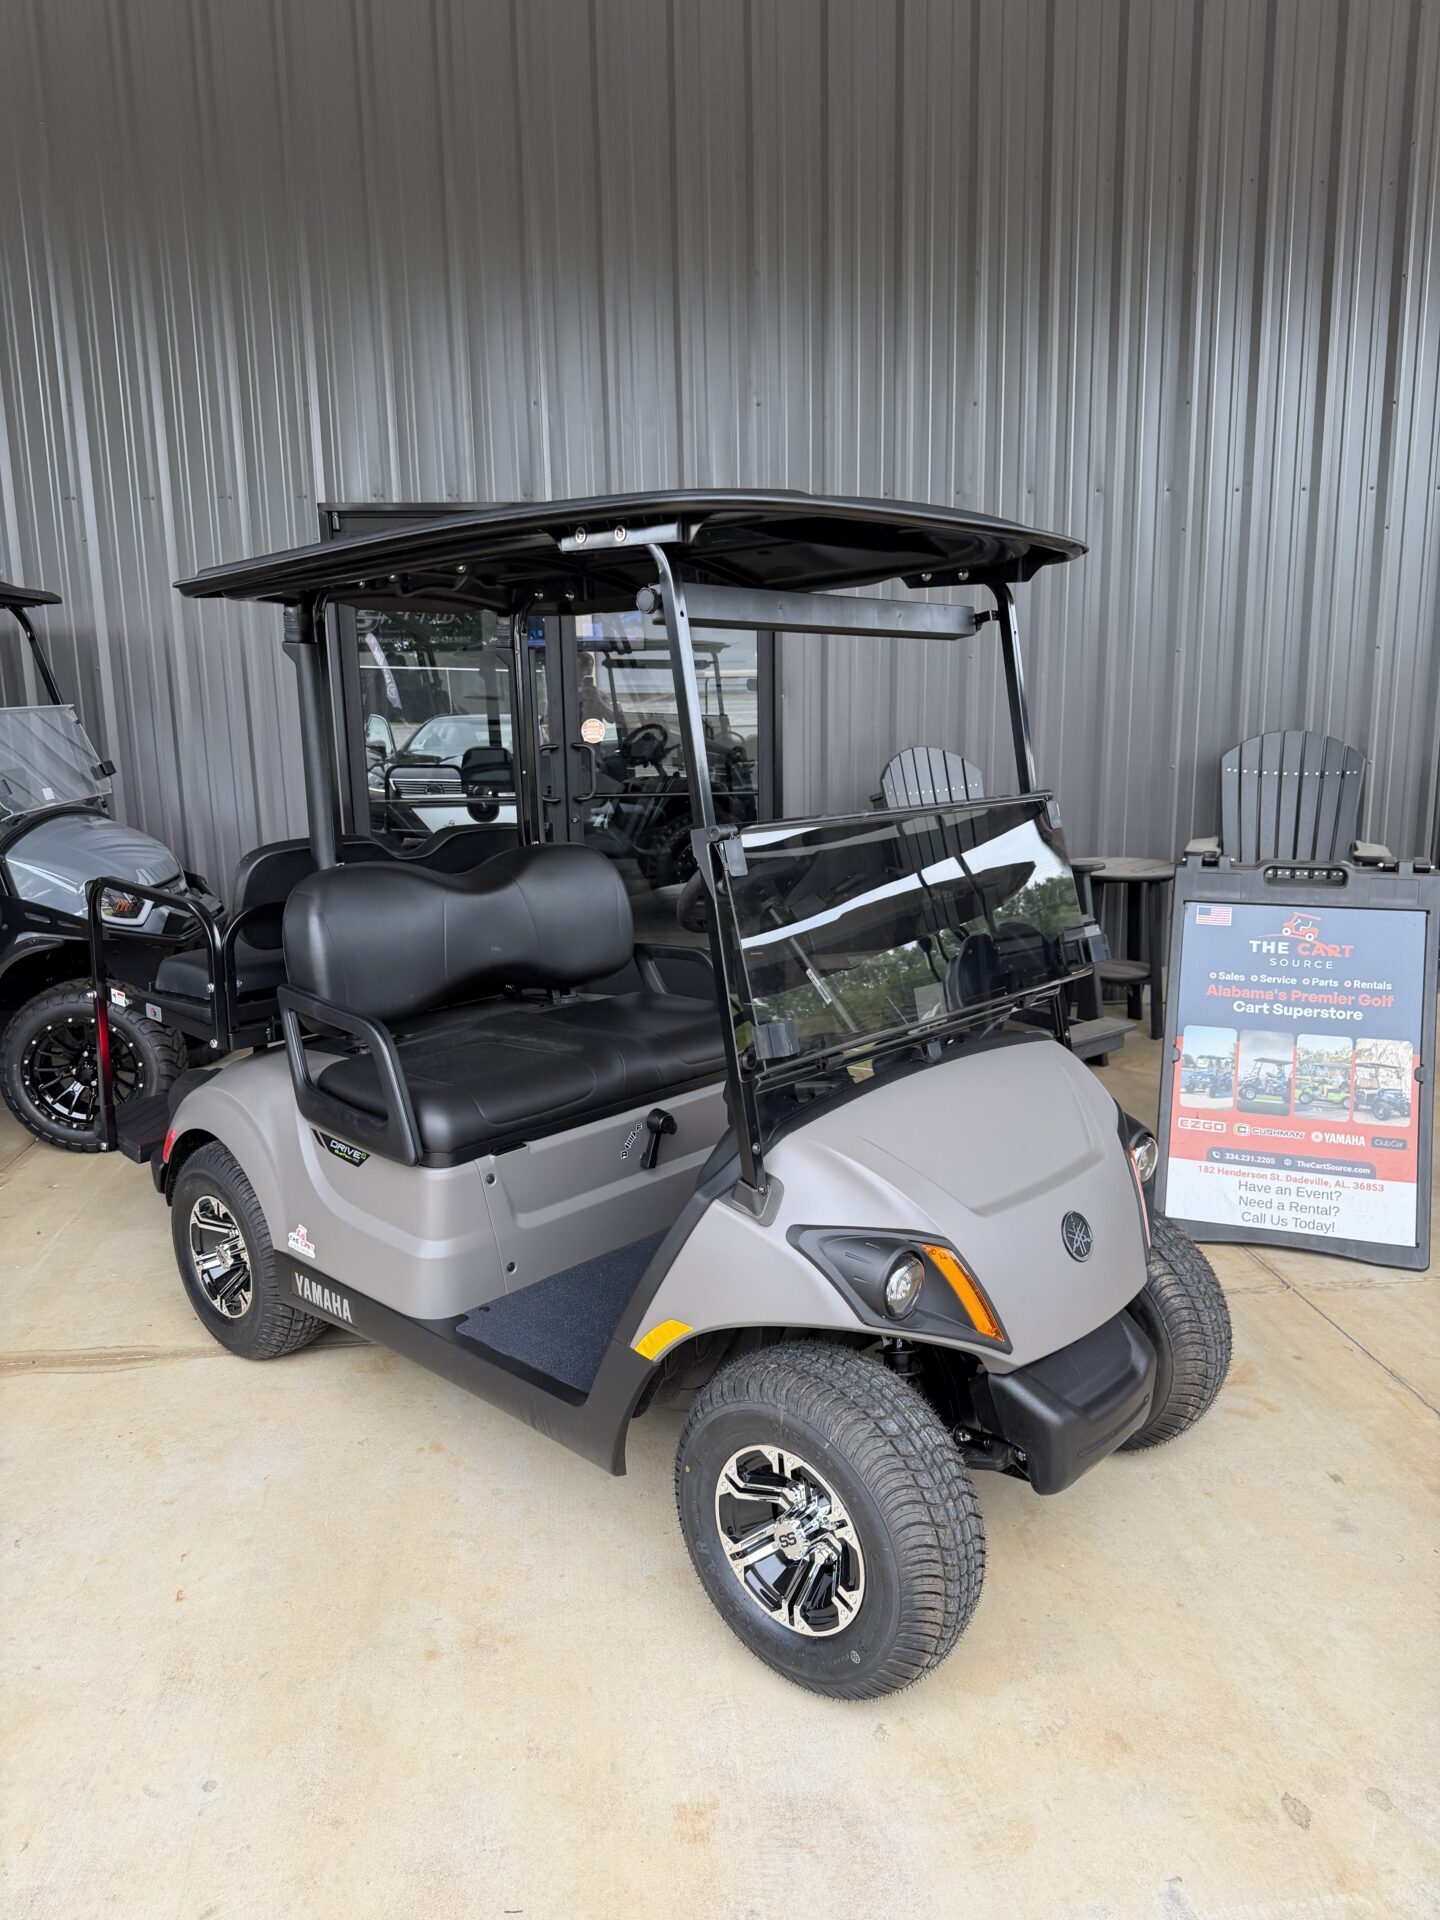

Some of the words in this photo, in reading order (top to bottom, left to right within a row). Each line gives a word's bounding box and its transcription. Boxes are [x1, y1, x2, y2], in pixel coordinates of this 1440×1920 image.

[1249, 940, 1290, 954] THE
[1297, 942, 1354, 957] CART
[1269, 958, 1333, 969] SOURCE
[1218, 971, 1246, 981] Sales
[1260, 974, 1297, 984] Service
[1312, 977, 1339, 987] Parts
[1353, 980, 1393, 990] Rentals
[1206, 984, 1287, 1001] Alabama's
[1290, 989, 1355, 1005] Premier
[1358, 993, 1394, 1007] Golf
[1233, 1000, 1270, 1014] Cart
[1272, 1003, 1363, 1021] Superstore
[1252, 1127, 1304, 1138] CUSHMAN
[1323, 1132, 1366, 1146] YAMAHA
[1224, 1152, 1276, 1164] 334.231.2205
[1296, 1160, 1371, 1174] TheCartSource.com
[1197, 1165, 1215, 1174] 182
[1217, 1167, 1268, 1179] Henderson
[1270, 1173, 1283, 1182] St.
[1285, 1174, 1332, 1188] Dadeville,
[1353, 1182, 1385, 1192] 36853
[1238, 1180, 1271, 1194] Have
[1276, 1186, 1292, 1196] an
[1296, 1186, 1342, 1201] Event?
[1238, 1195, 1273, 1209] Need
[1276, 1202, 1285, 1211] a
[1289, 1201, 1340, 1217] Rental?
[1241, 1211, 1266, 1224] Call
[1270, 1215, 1288, 1226] Us
[1292, 1217, 1335, 1234] Today!
[294, 1271, 353, 1324] YAMAHA
[779, 1531, 797, 1548] SS
